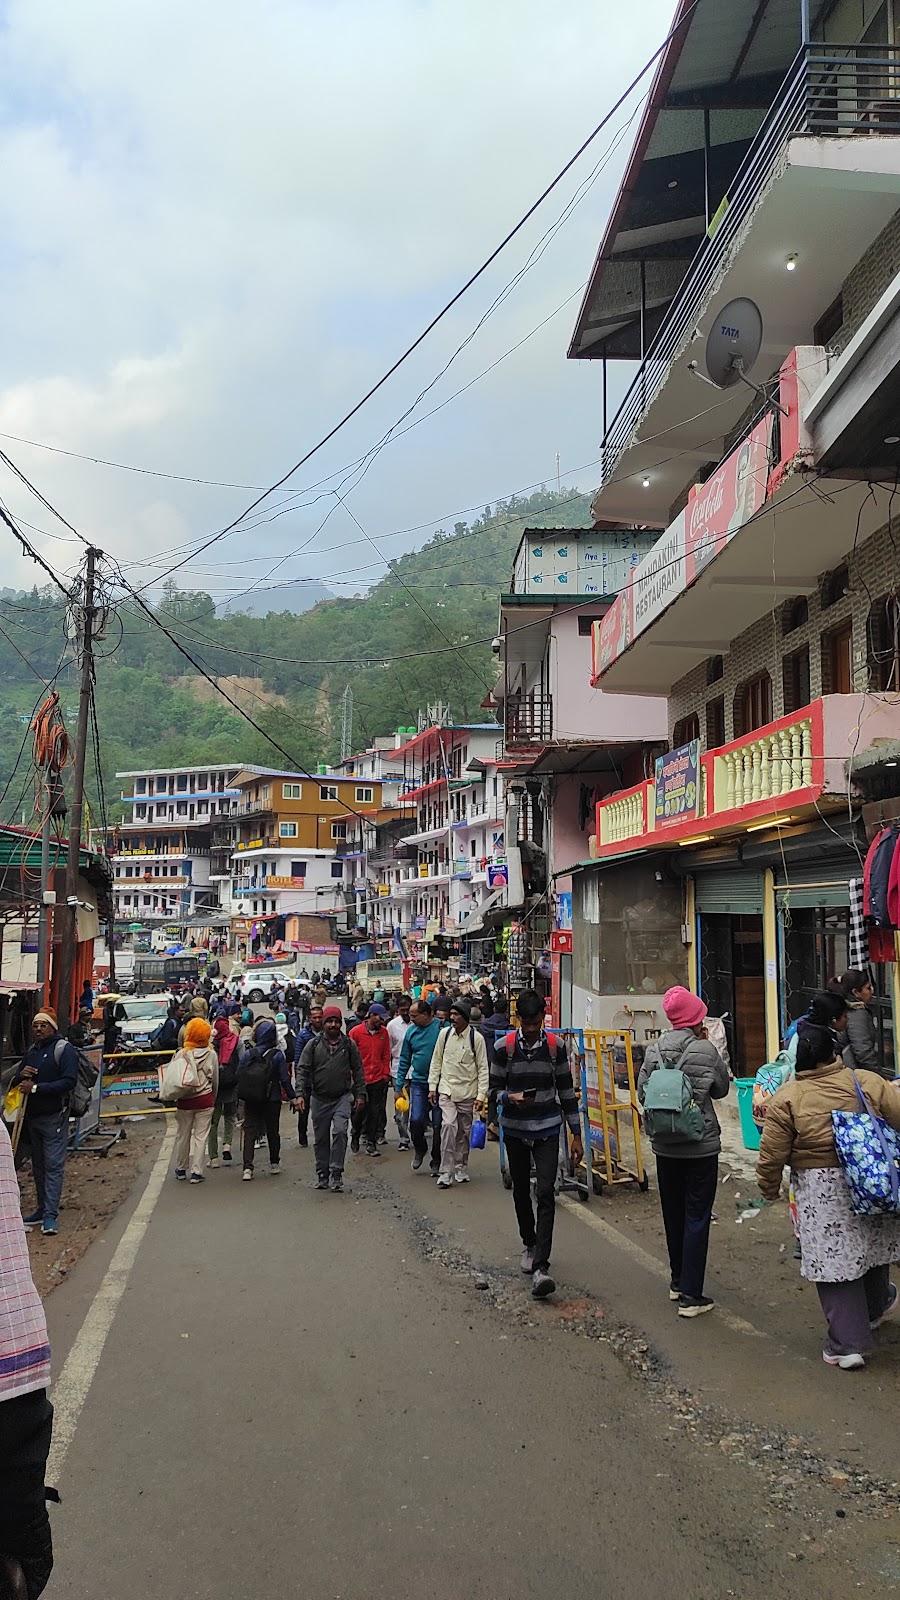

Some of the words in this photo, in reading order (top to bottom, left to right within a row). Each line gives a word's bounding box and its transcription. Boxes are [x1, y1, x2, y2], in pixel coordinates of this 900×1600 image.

[721, 326, 740, 339] TATA
[637, 533, 679, 597] MANDAKINI
[635, 561, 682, 623] RESTAURANT
[267, 876, 293, 884] HOTEL
